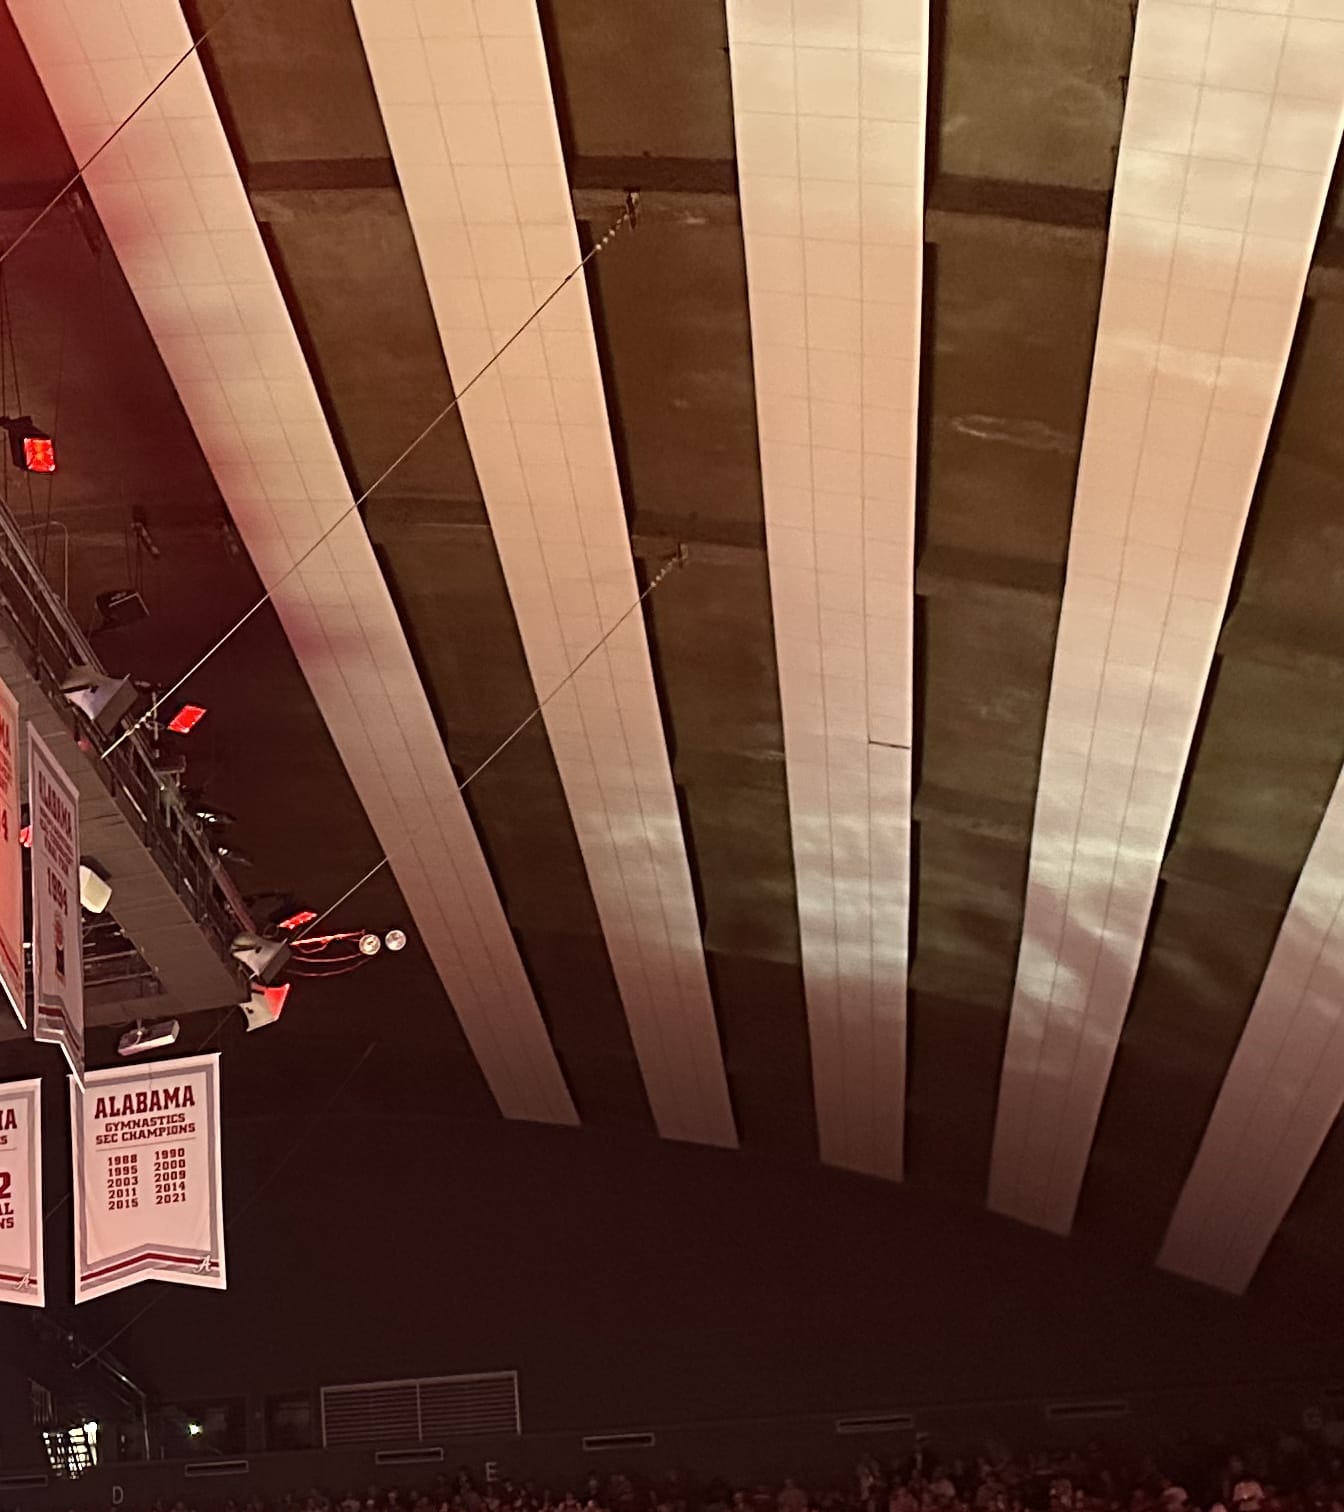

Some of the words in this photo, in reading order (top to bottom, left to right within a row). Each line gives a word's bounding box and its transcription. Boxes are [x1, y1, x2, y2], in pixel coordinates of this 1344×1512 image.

[94, 1085, 196, 1120] ALABAMA
[104, 1113, 185, 1134] GYMNASTICS
[95, 1132, 118, 1146] SEC
[122, 1122, 196, 1142] CHAMPIONS
[154, 1148, 185, 1161] 1990
[107, 1164, 138, 1177] 1995
[153, 1159, 186, 1172] 2000
[107, 1175, 138, 1188] 2003
[154, 1170, 186, 1183] 2009
[108, 1186, 137, 1199] 2011
[155, 1181, 186, 1194] 2014
[108, 1196, 138, 1210] 2015
[155, 1191, 186, 1205] 2021
[112, 1485, 124, 1505] D
